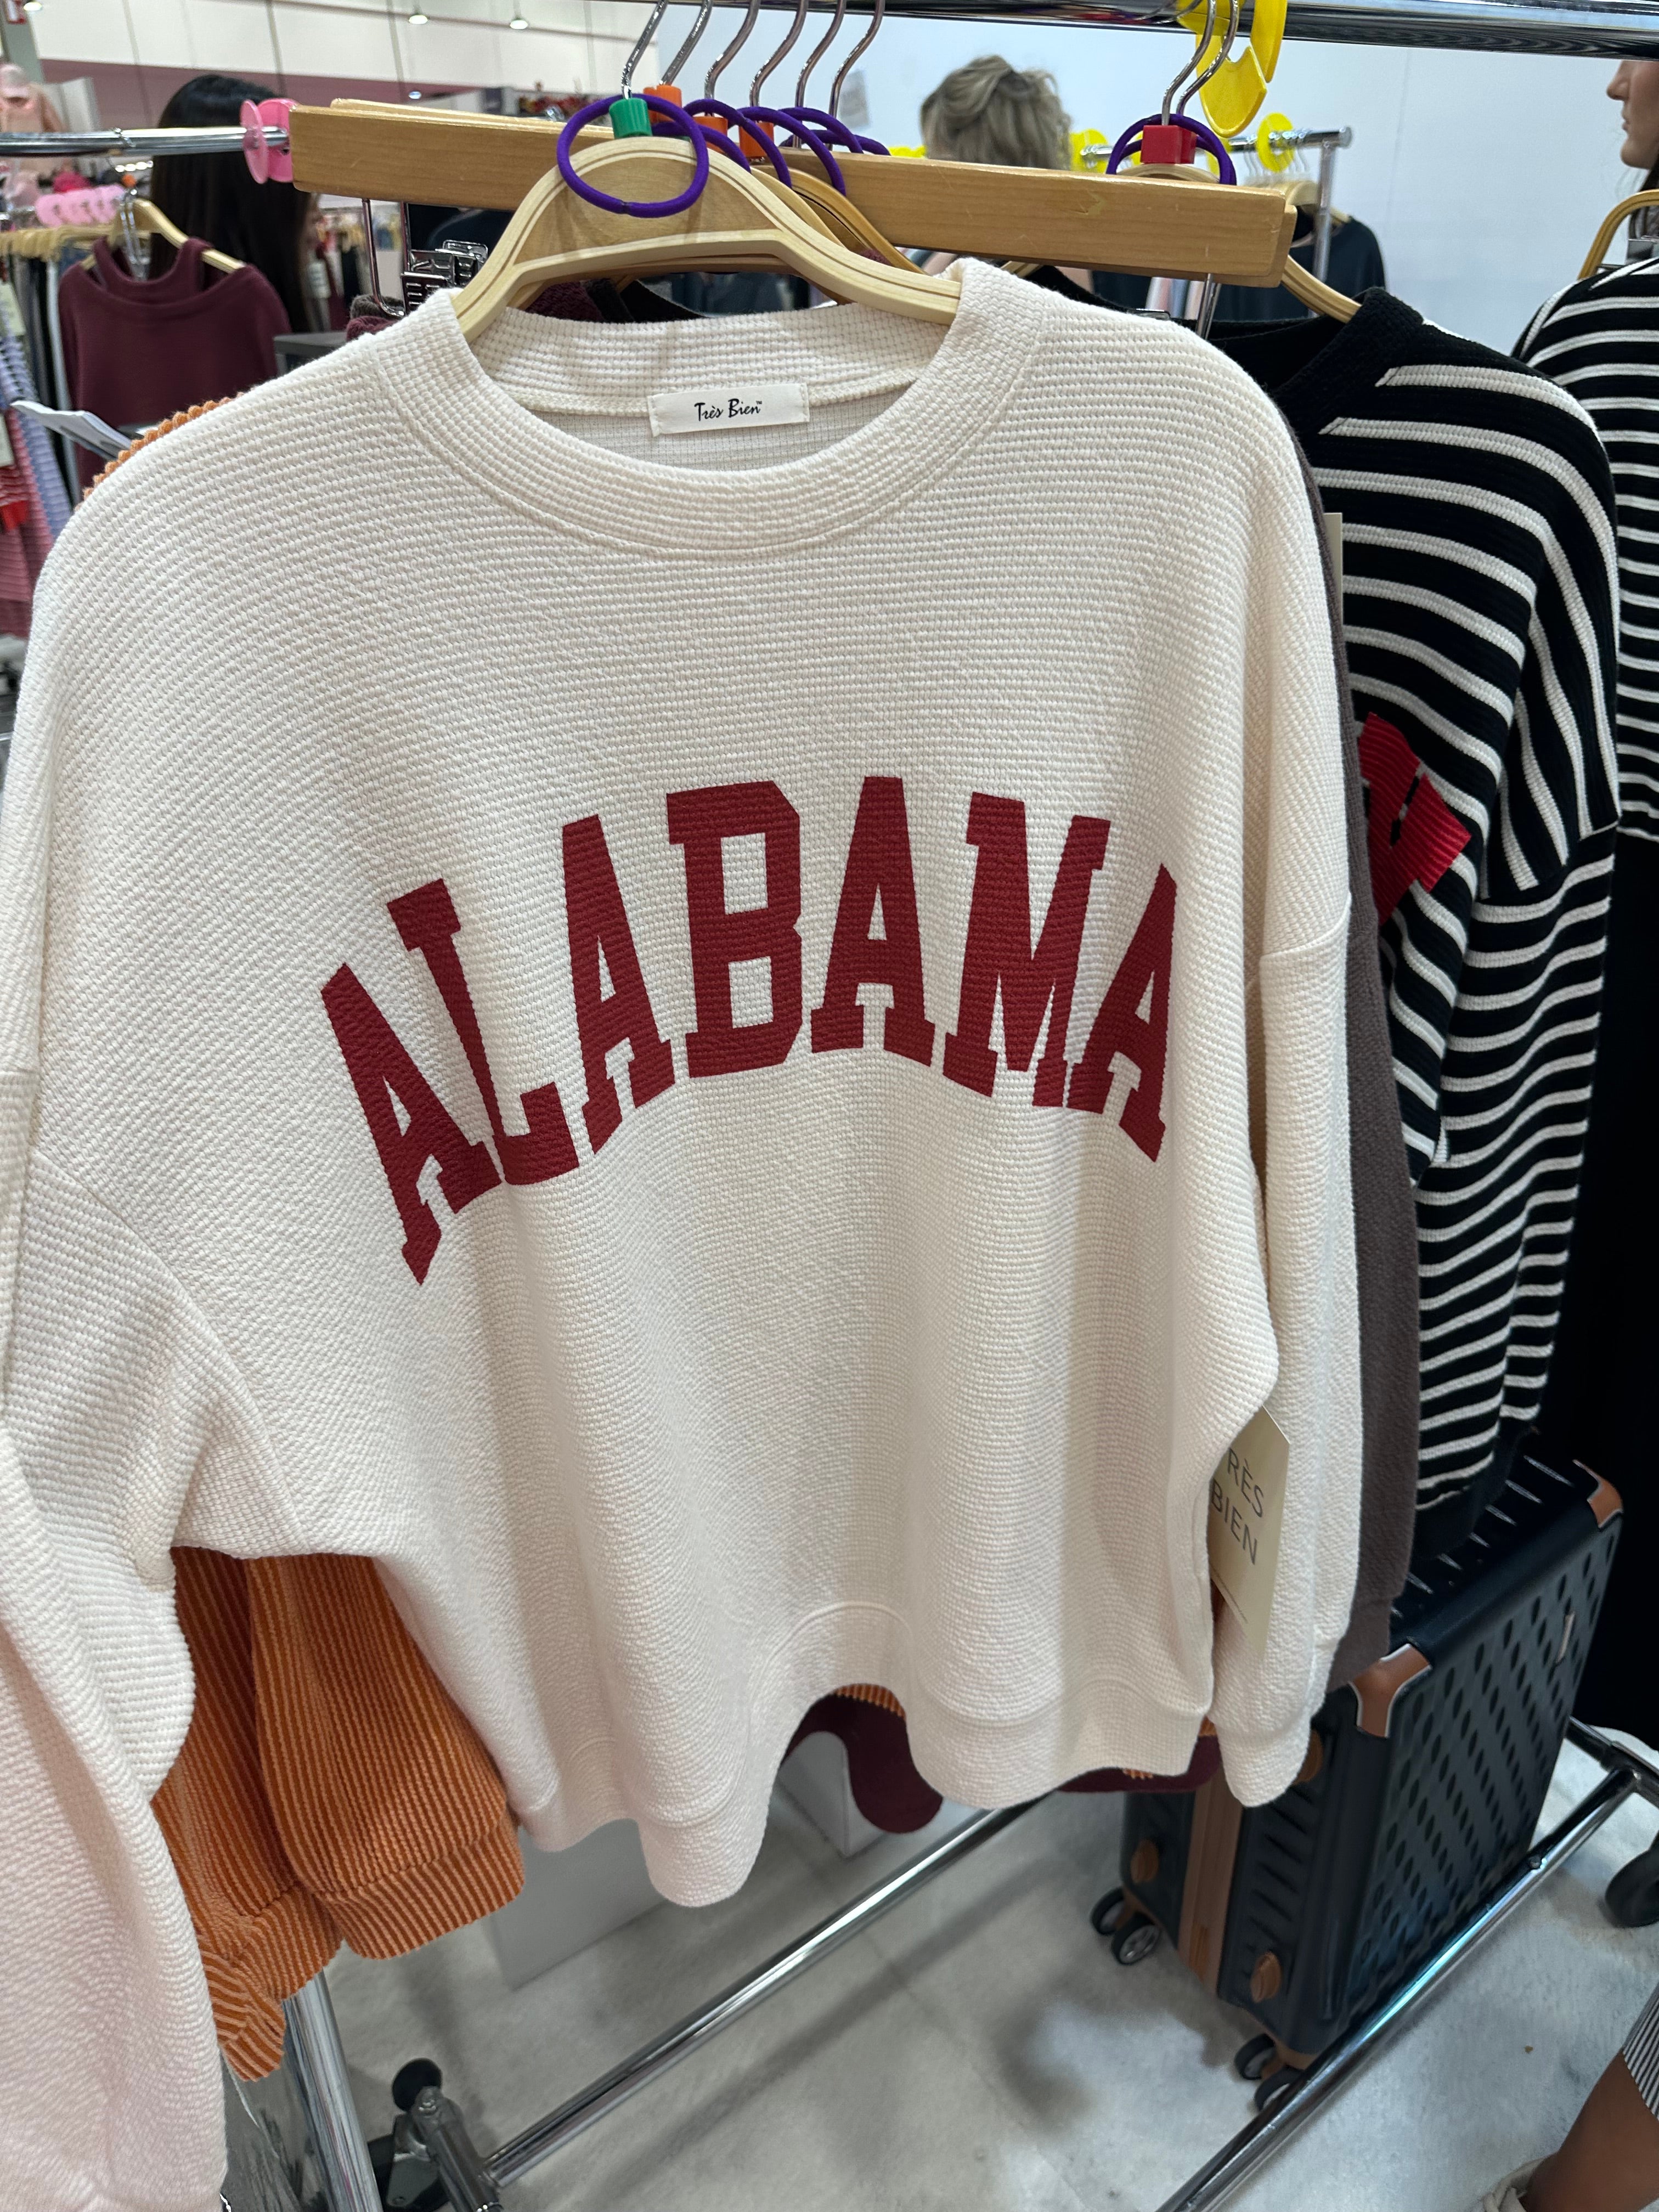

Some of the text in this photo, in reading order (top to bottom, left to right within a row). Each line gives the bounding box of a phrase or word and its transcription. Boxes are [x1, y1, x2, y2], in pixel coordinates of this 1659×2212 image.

[693, 402, 724, 422] Très
[320, 776, 1177, 1285] ALABAMA
[1211, 1477, 1258, 1566] BIEN
[1227, 1447, 1264, 1519] RÈS
